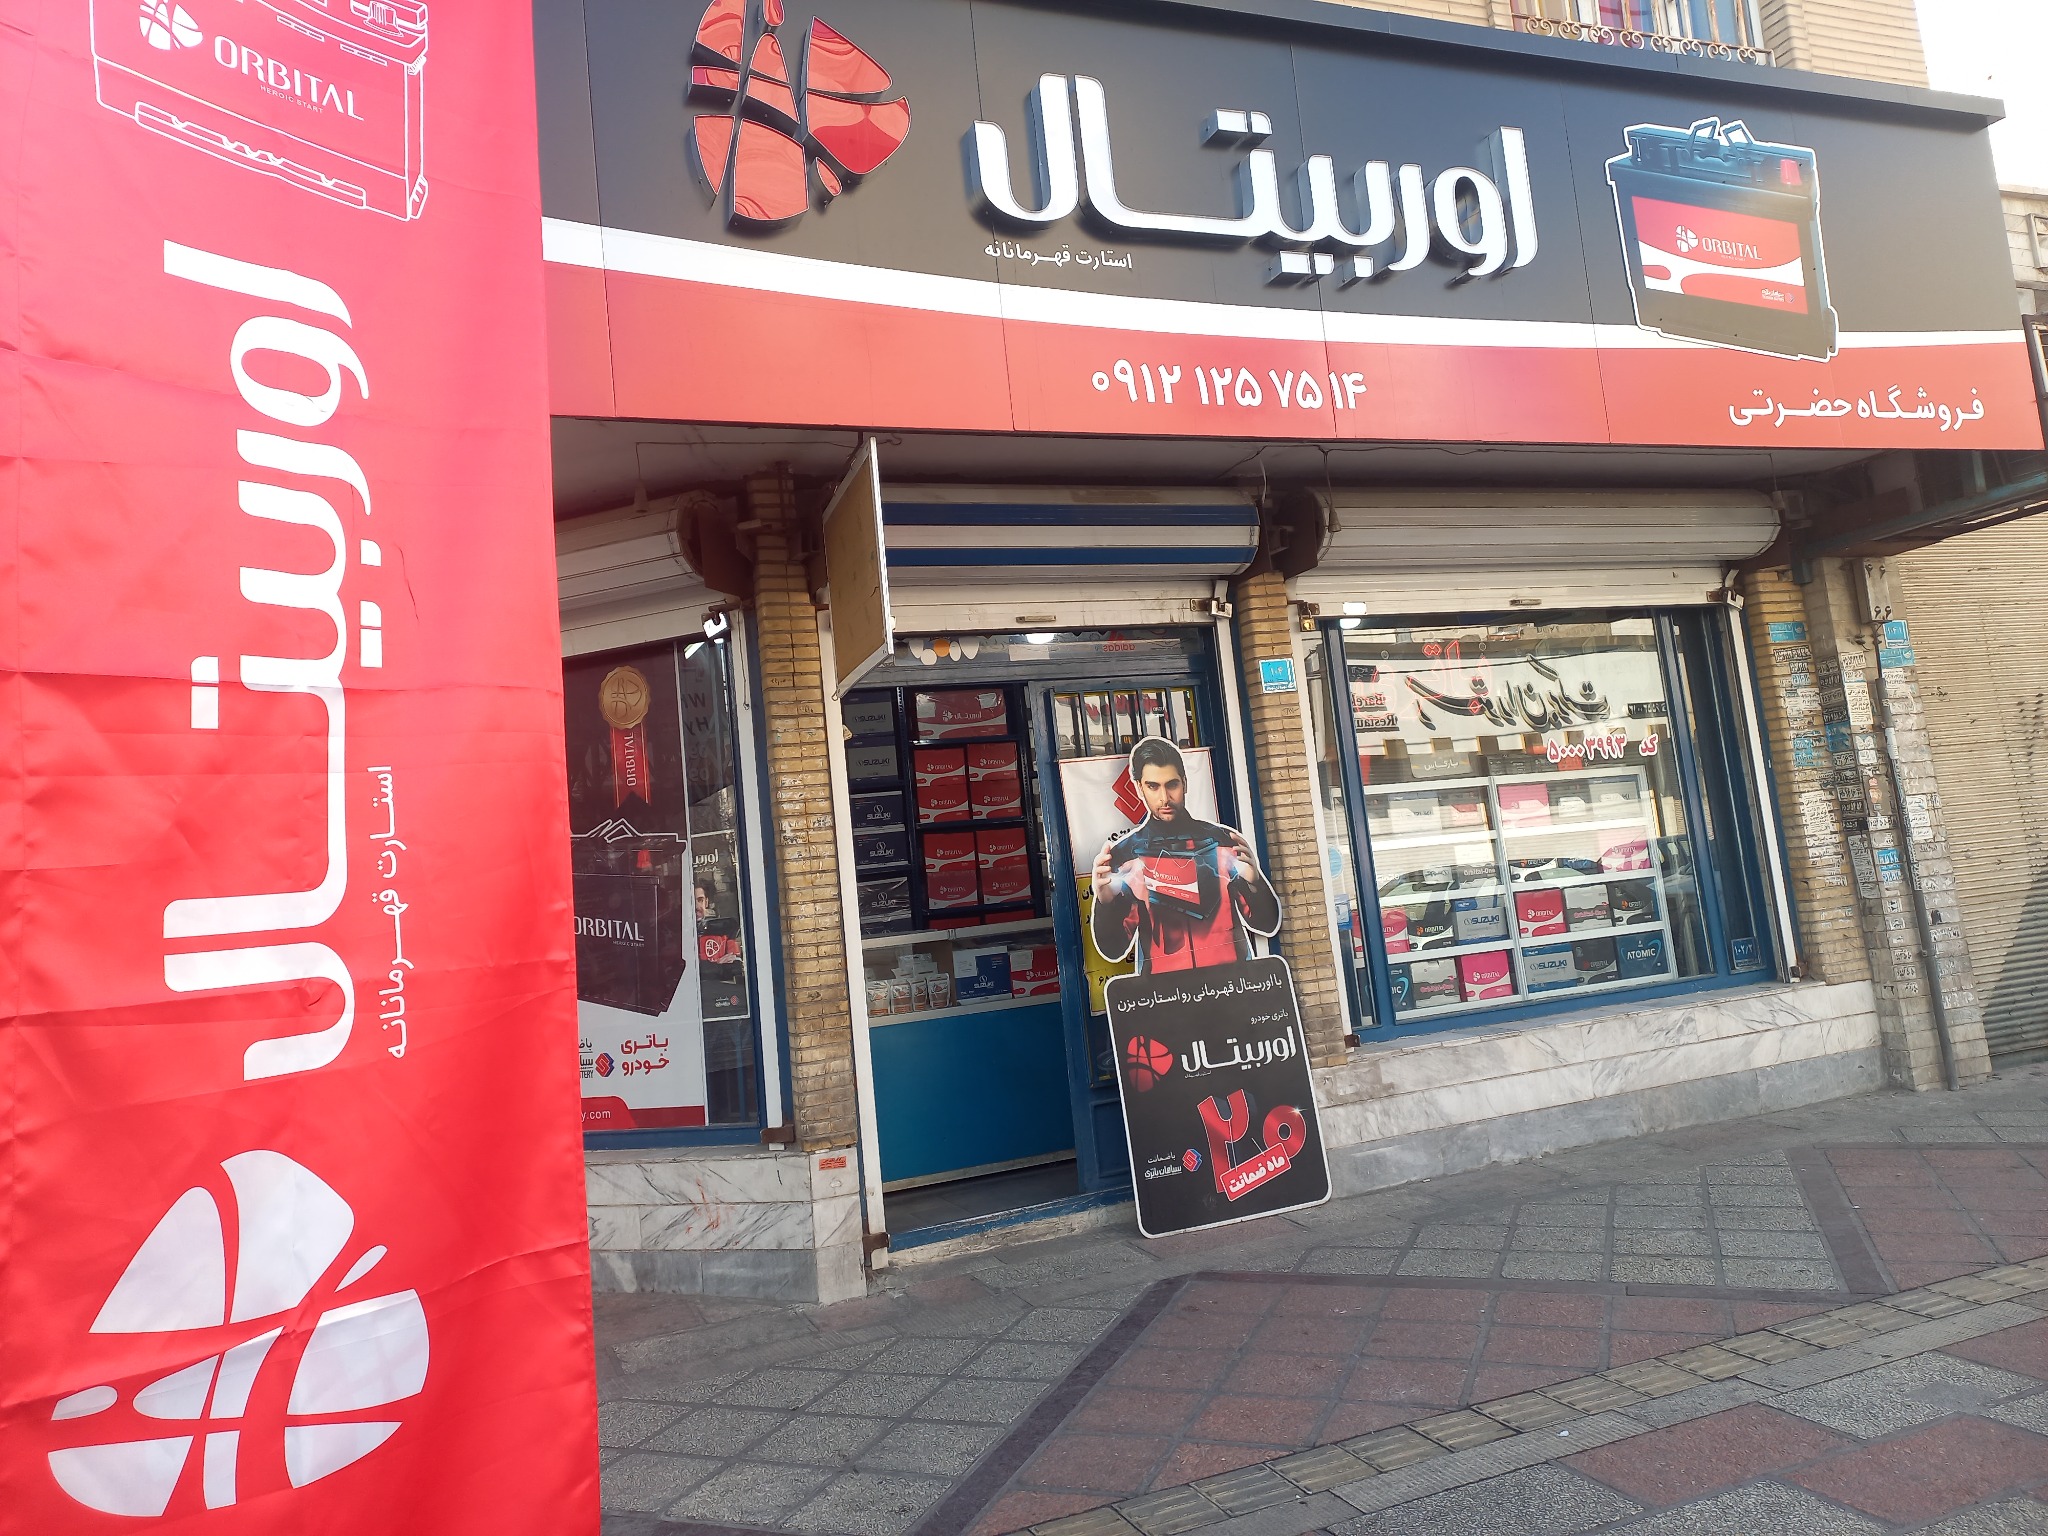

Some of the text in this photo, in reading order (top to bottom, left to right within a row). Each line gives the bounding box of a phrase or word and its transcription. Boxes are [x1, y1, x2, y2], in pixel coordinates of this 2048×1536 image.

[213, 34, 365, 122] ORBITAL
[259, 84, 325, 115] HEROIC START
[968, 72, 1539, 279] اوربیتال
[982, 240, 1134, 271] استارت قهرمانانه
[1701, 236, 1763, 261] ORBITAL
[1090, 358, 1183, 404] ۰۹۱۲
[1728, 383, 1985, 432] فروشگاه حضرتی
[162, 239, 384, 1081] اوربیتال
[623, 731, 637, 787] ORBITAL
[1547, 733, 1660, 764] کد ۵۰۰۰۳۹۹۳
[863, 757, 890, 766] SUZUKI
[866, 812, 891, 820] SUZUKI
[869, 848, 895, 858] SUZUKI
[368, 765, 414, 1059] استارت قهرمانانه
[1471, 914, 1500, 925] SUZUKI
[1538, 960, 1568, 970] SUZUKI
[1627, 948, 1657, 960] ATOMIC
[973, 981, 995, 989] SUZUKI
[1192, 980, 1235, 1003] قهرمانی
[1117, 998, 1136, 1014] بزن
[1137, 986, 1181, 1010] استارت
[1250, 1008, 1289, 1025] باتری خودرو
[620, 1033, 669, 1055] باتری
[1180, 1025, 1298, 1072] اوربیتال
[621, 1053, 670, 1077] خودرو
[1228, 1154, 1286, 1194] ماه ضمانت
